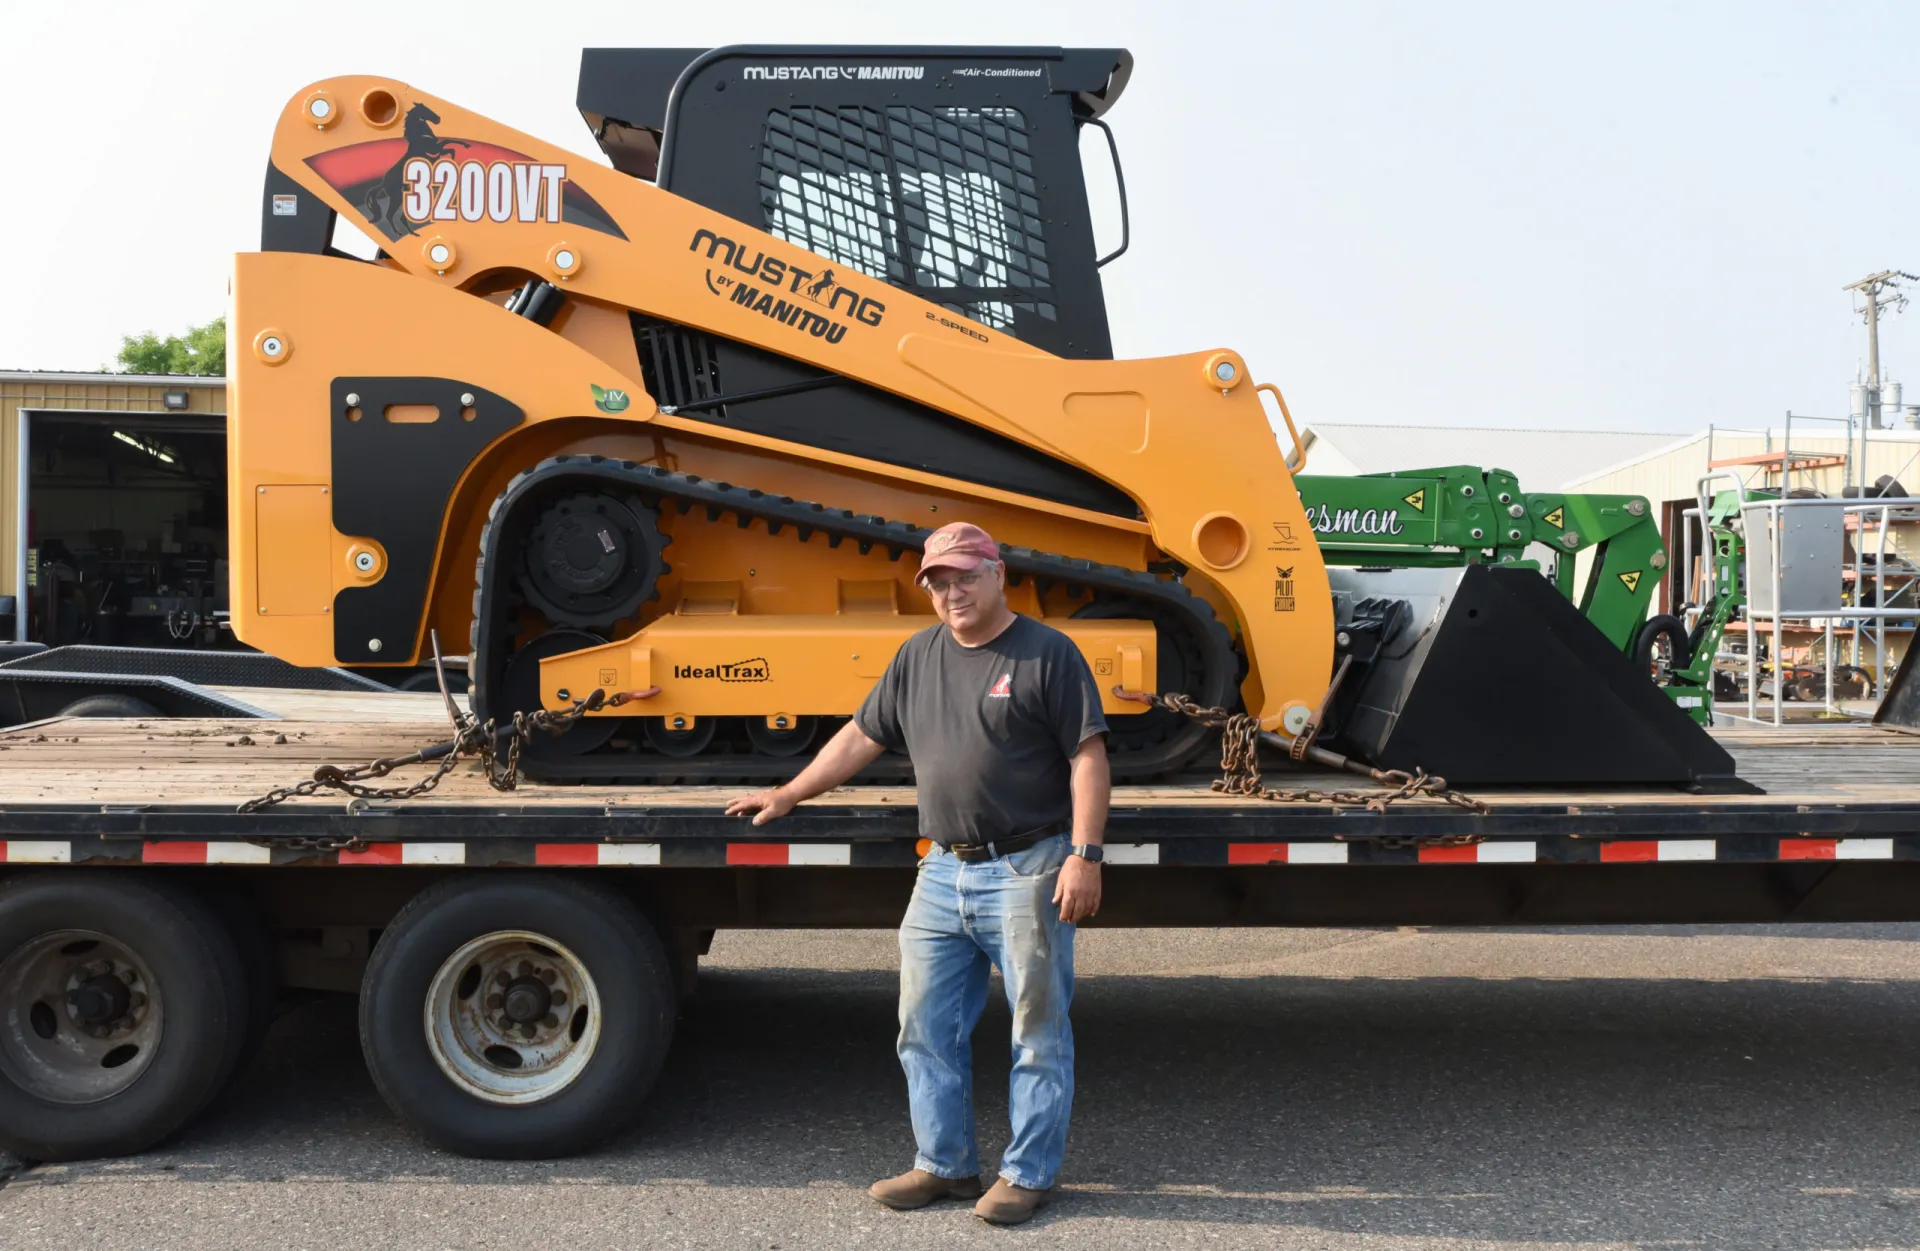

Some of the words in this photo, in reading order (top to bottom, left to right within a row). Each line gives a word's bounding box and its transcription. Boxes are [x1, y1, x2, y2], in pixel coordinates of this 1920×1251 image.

[744, 66, 838, 80] MUSTANG
[858, 66, 925, 80] MANITOU
[966, 68, 1042, 77] Air-Conditioned
[404, 159, 567, 224] 3200VT
[716, 275, 735, 288] BY
[729, 282, 848, 345] MANITOU
[925, 311, 989, 343] 2-SPEED
[1303, 502, 1403, 535] esman
[1275, 580, 1294, 596] PILOT
[674, 664, 764, 679] IdealTrax
